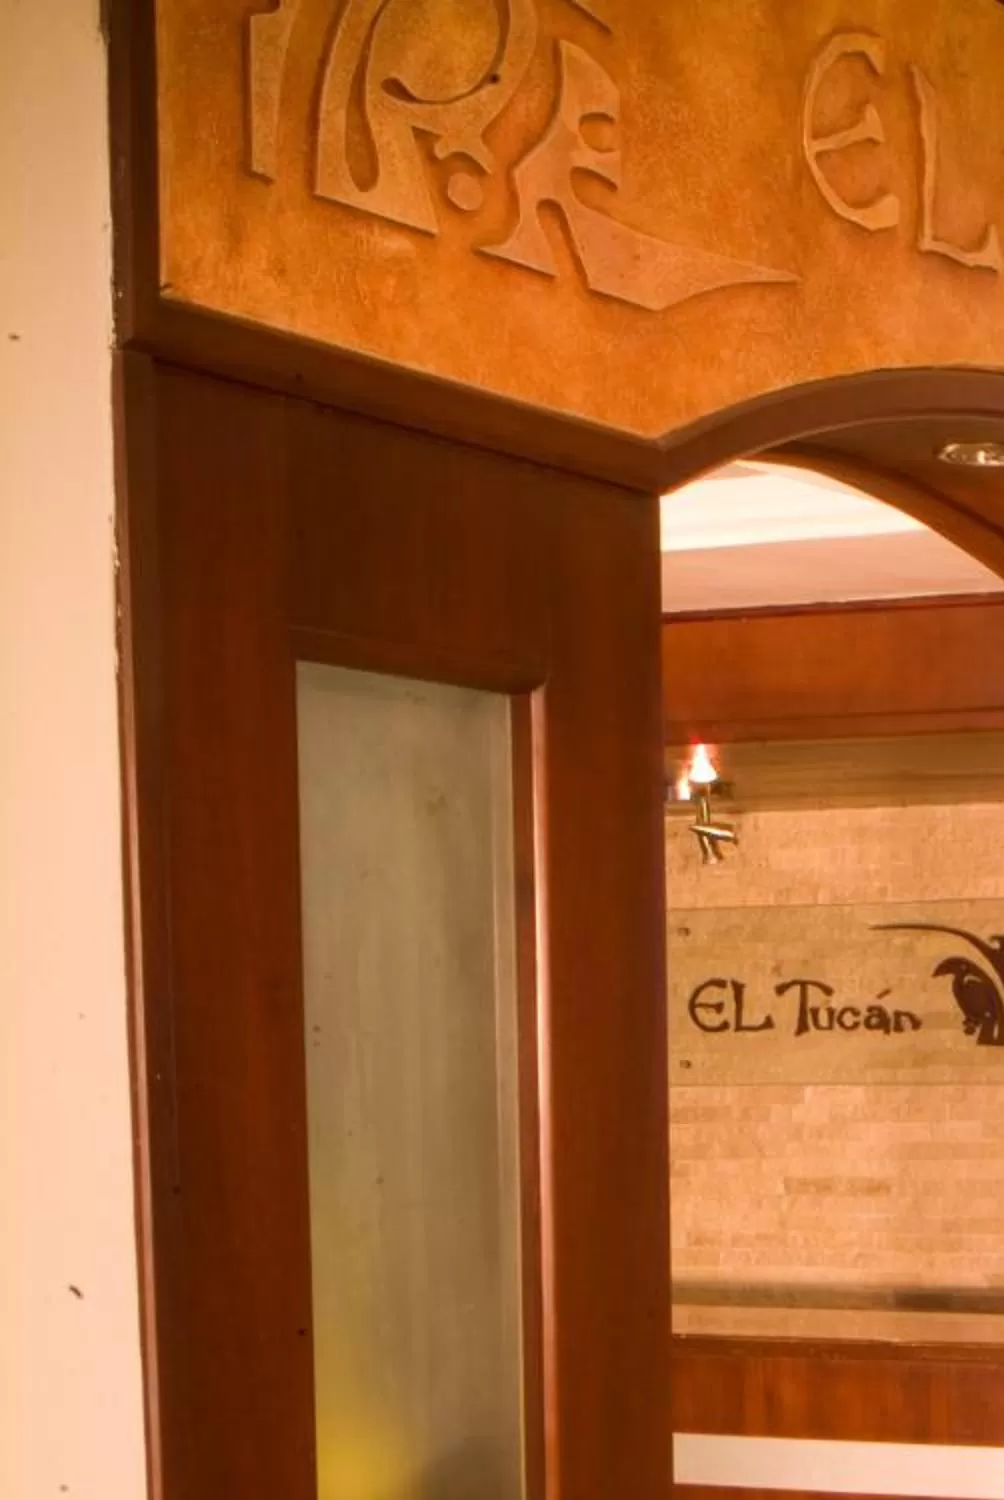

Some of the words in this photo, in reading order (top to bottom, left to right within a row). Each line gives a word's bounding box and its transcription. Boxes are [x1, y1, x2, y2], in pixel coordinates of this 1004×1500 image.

[801, 29, 1000, 272] EL
[687, 976, 774, 1034] EL
[774, 978, 923, 1038] Tucán
